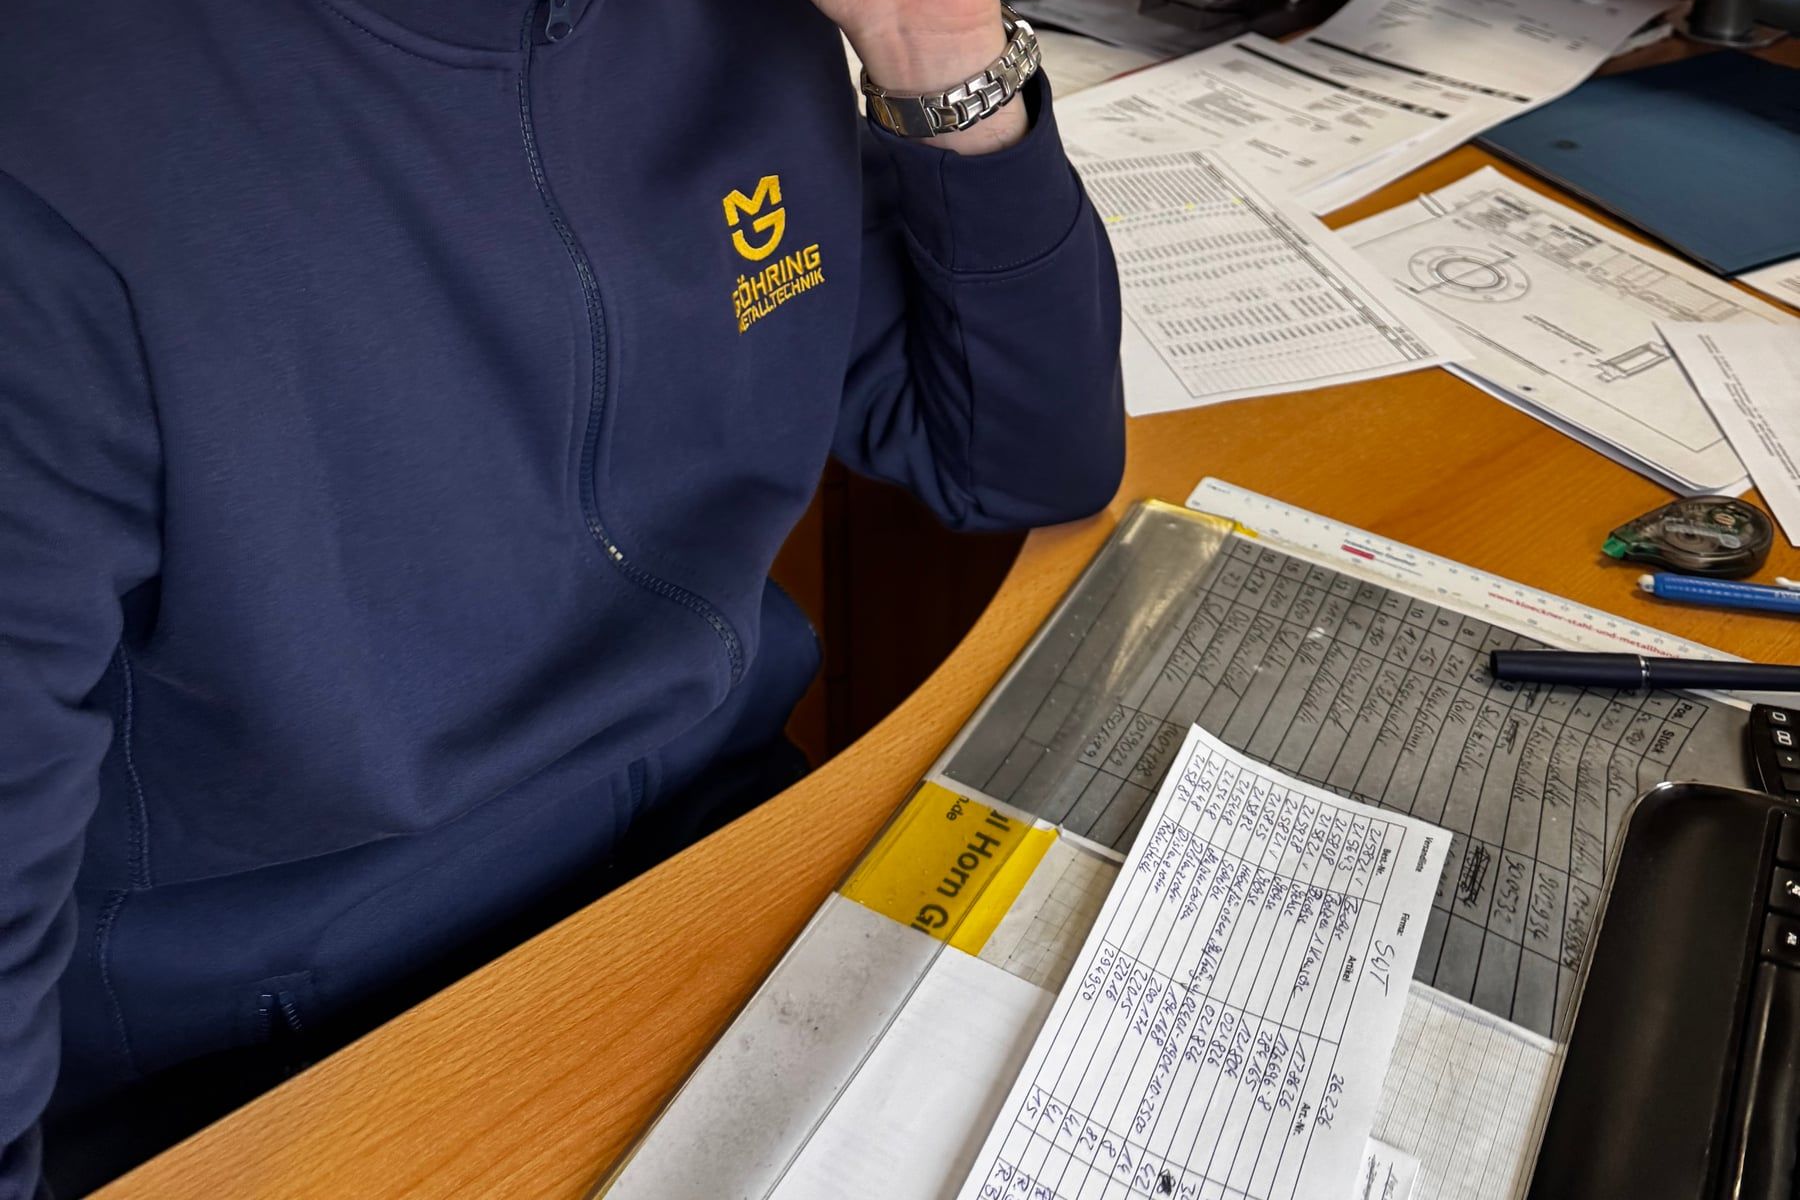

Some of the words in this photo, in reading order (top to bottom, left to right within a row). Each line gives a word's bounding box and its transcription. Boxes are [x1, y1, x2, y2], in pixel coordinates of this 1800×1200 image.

[1386, 598, 1398, 608] 11
[1411, 608, 1424, 618] 10
[1671, 703, 1692, 719] Pos.
[1652, 730, 1675, 753] Stück
[936, 831, 1001, 898] Horn
[1376, 848, 1391, 876] Best.-Nr.
[1415, 837, 1433, 872] Versandliste
[1397, 913, 1410, 936] Firma:
[1106, 957, 1131, 1001] 22016
[1342, 955, 1356, 982] Artikel
[1121, 966, 1148, 1019] 22015
[1314, 1074, 1344, 1129] 26.2.26
[1293, 1102, 1311, 1135] Art.-Nr.
[1097, 1137, 1116, 1158] 8
